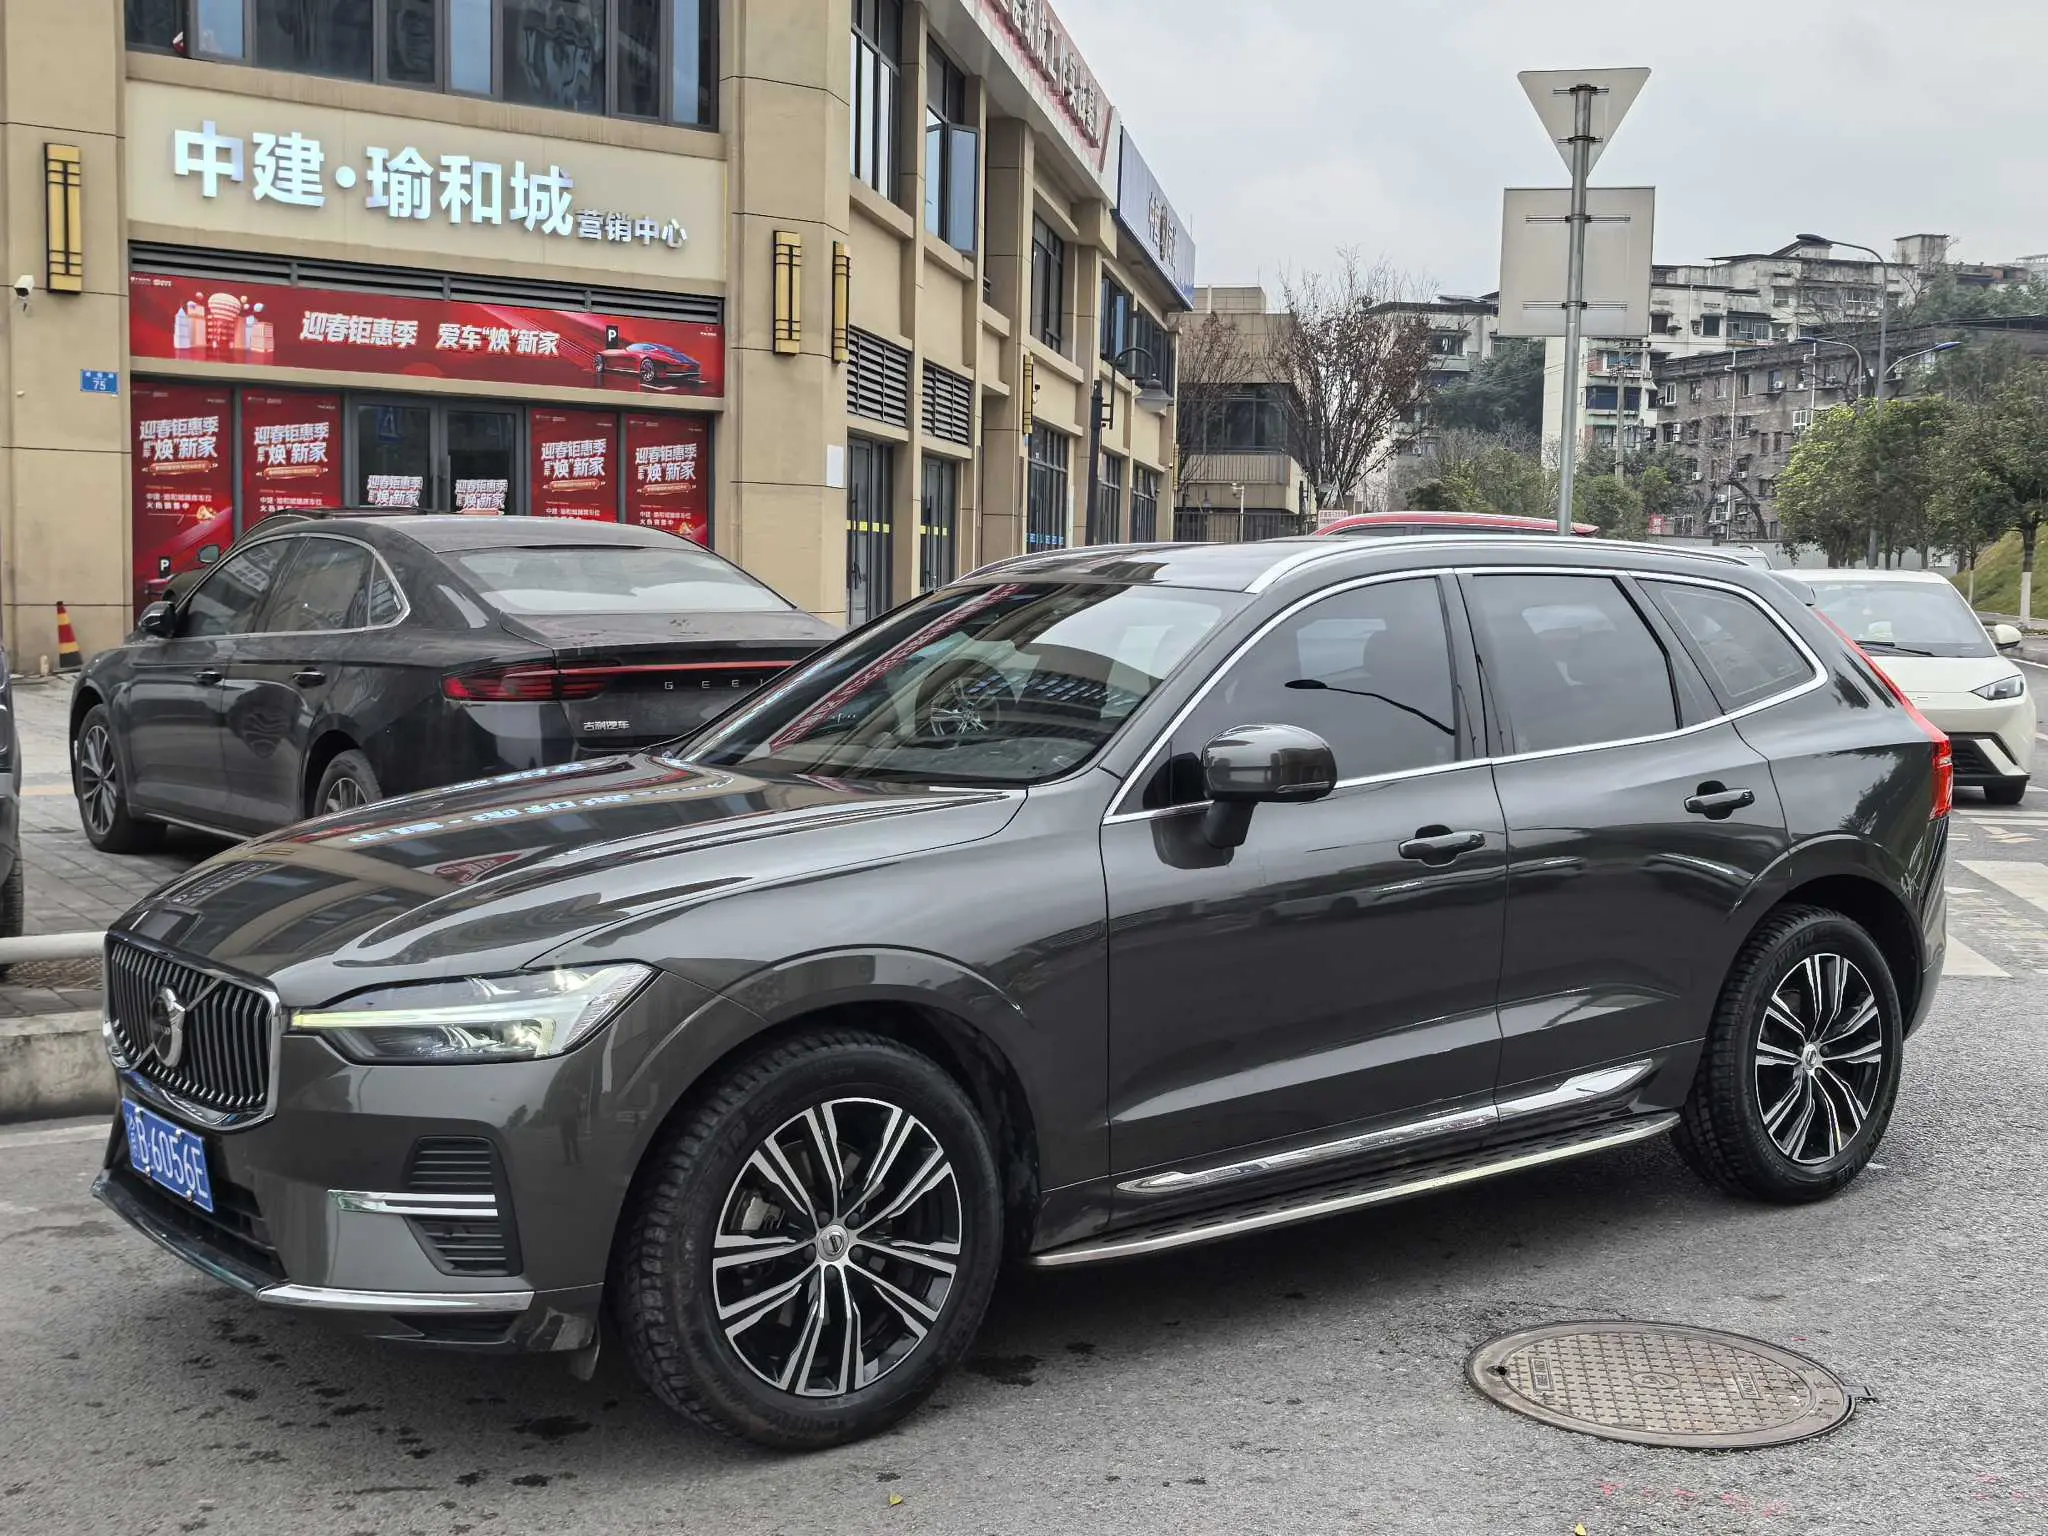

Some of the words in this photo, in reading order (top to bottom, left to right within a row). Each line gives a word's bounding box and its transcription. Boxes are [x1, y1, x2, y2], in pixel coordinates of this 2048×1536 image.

[174, 120, 574, 236] 中建·瑜和城
[576, 208, 687, 248] 营销中心
[301, 311, 418, 348] 迎春钜惠季
[608, 329, 617, 342] P
[93, 380, 106, 390] 75
[140, 416, 219, 440] 迎春钜惠季
[254, 422, 329, 446] 迎春钜惠季
[541, 438, 607, 460] 迎春钜惠季
[635, 443, 697, 464] 迎春钜惠季
[160, 559, 169, 571] P
